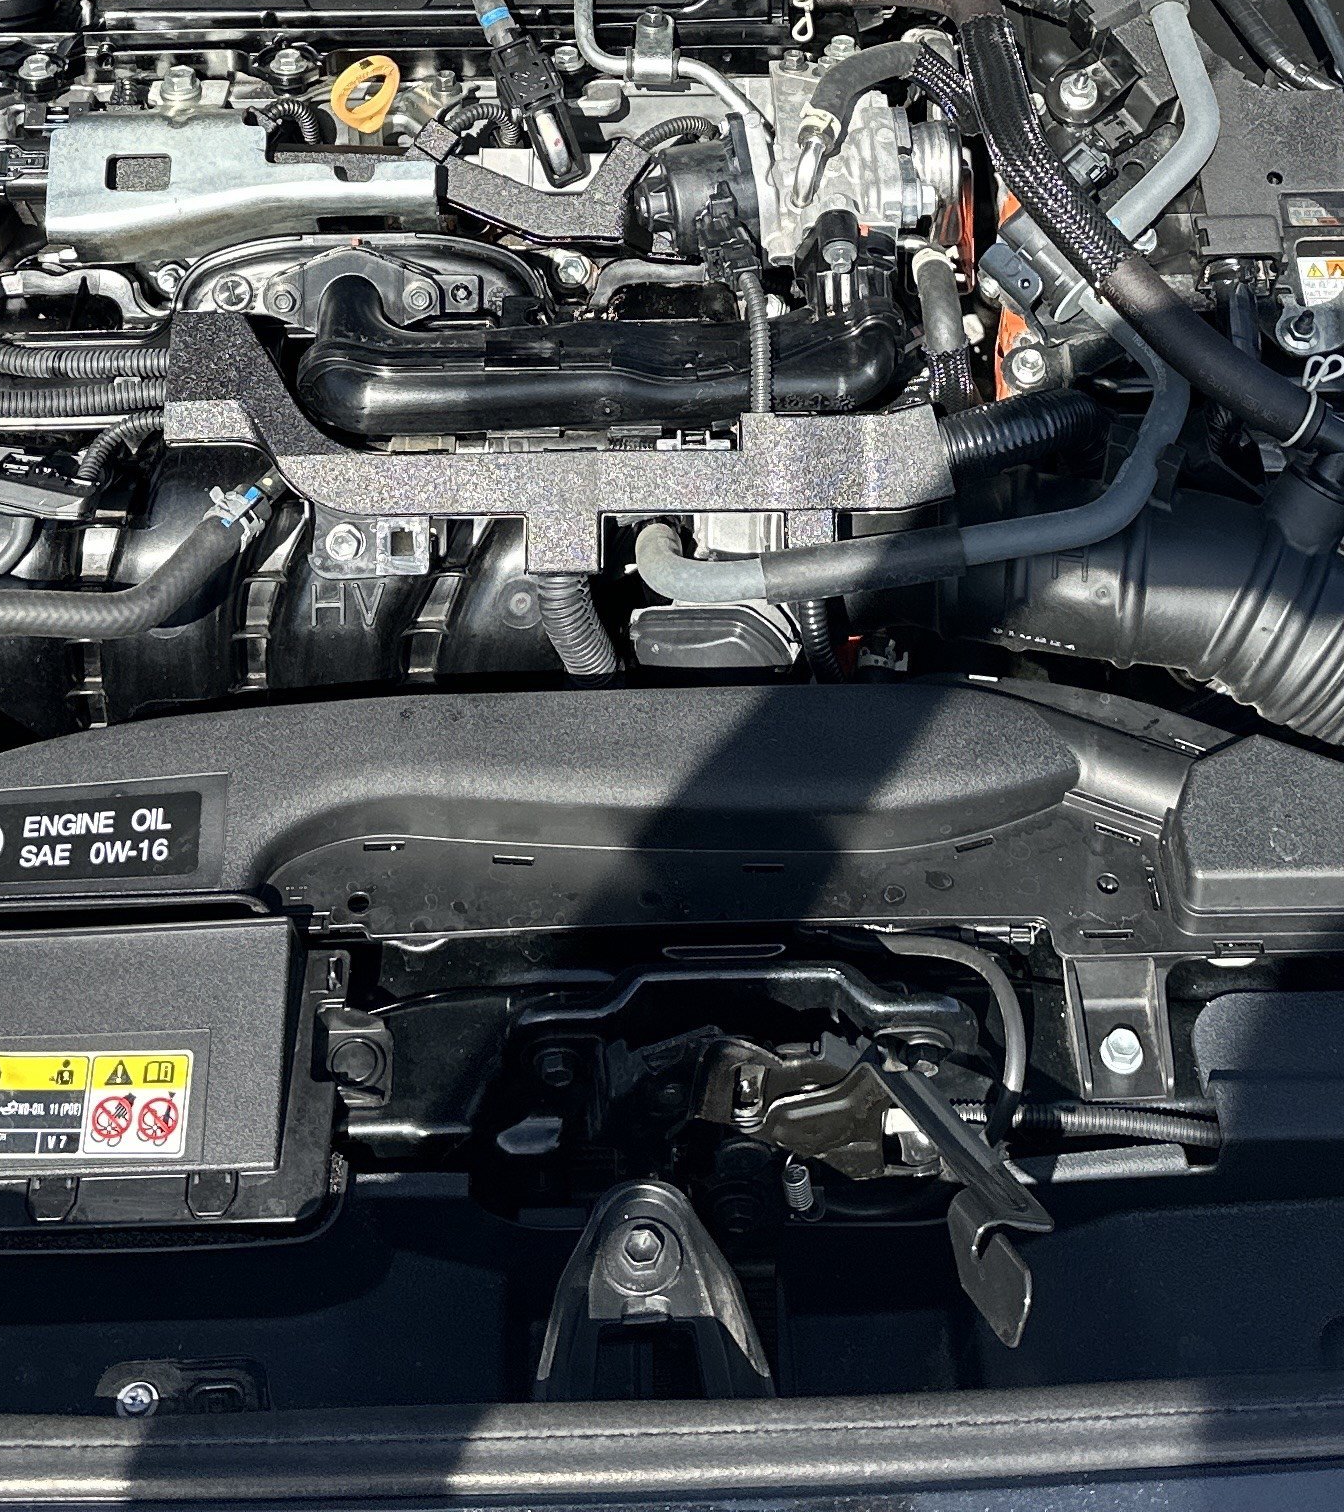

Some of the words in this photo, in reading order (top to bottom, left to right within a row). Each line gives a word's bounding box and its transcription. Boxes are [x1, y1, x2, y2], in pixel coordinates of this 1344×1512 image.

[310, 582, 386, 629] HV
[22, 811, 116, 838] ENGINE
[131, 807, 172, 833] OIL
[19, 844, 72, 868] SAE
[89, 838, 169, 865] 0W-16
